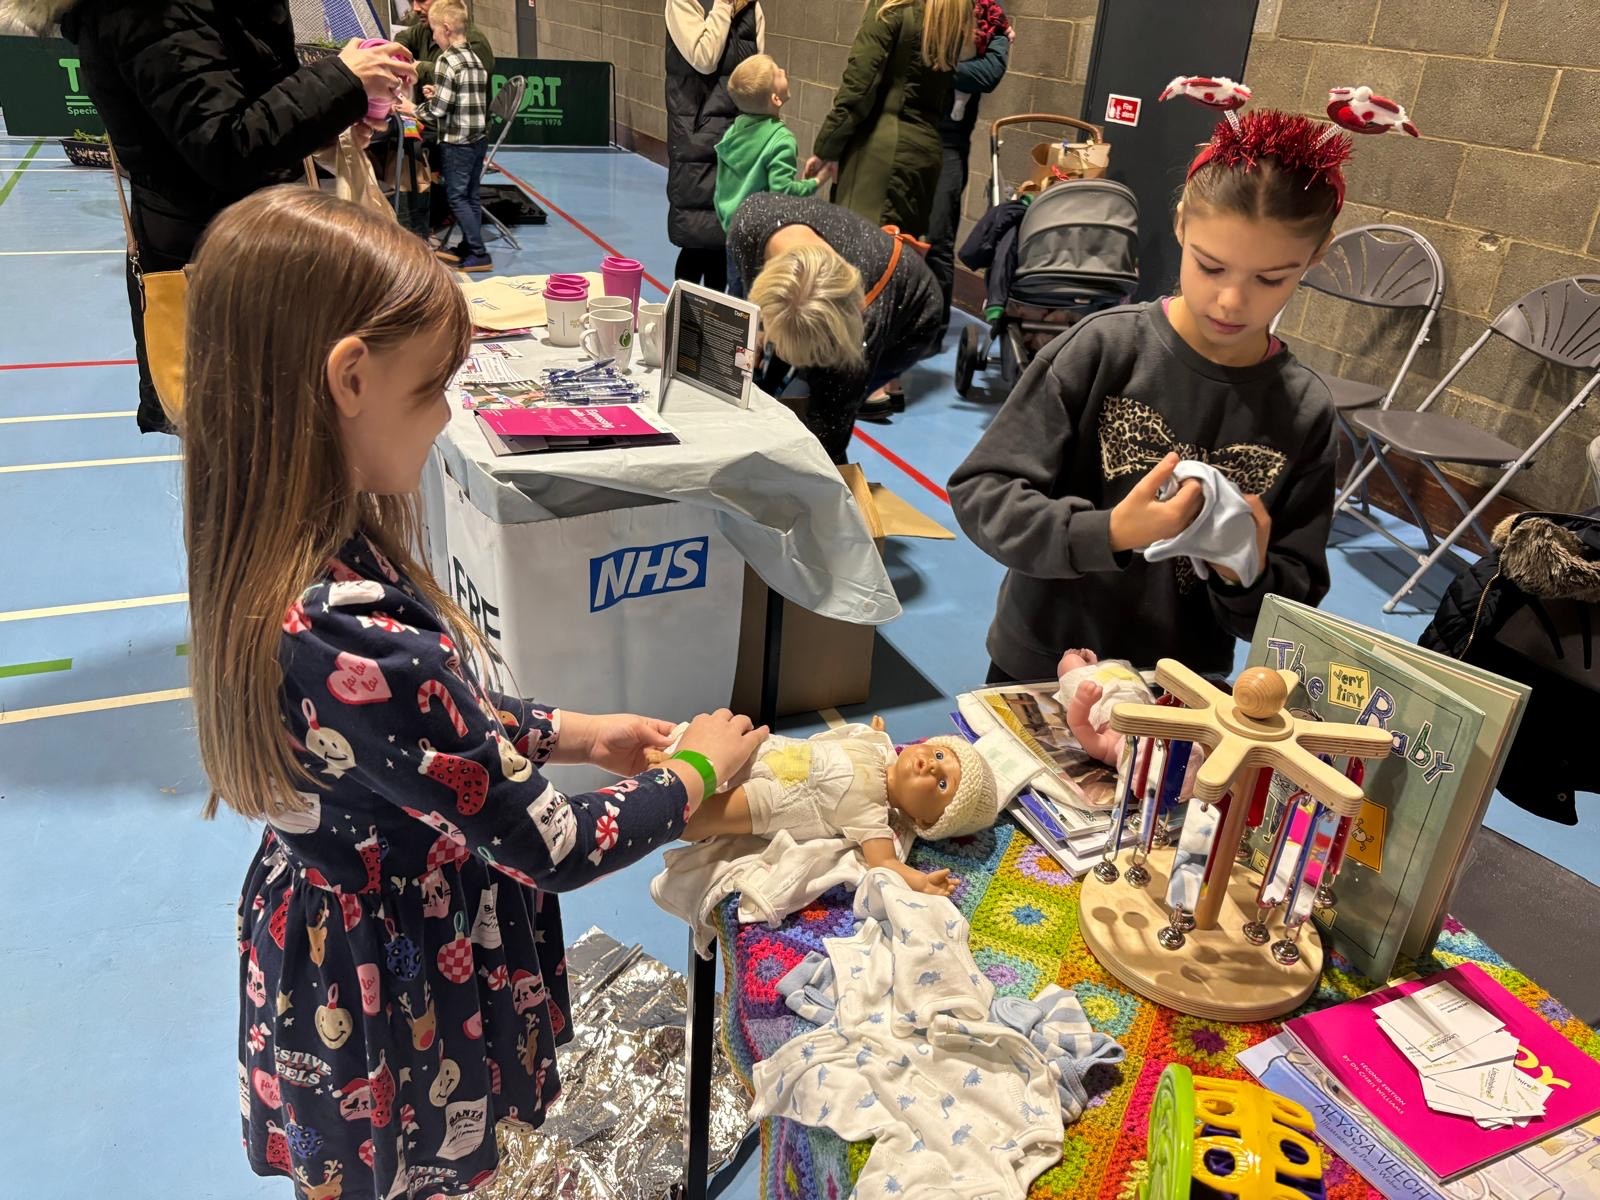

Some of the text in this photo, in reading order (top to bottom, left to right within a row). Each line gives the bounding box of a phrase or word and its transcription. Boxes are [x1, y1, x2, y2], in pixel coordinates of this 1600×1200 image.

[523, 118, 542, 126] Since
[593, 541, 704, 608] NHS
[342, 662, 366, 694] fa la
[361, 677, 378, 692] la
[1267, 638, 1325, 701] The
[1336, 684, 1365, 707] tiny
[1360, 1062, 1406, 1106] SECOND EDITION
[1376, 1087, 1405, 1115] WILLIAMS
[449, 1109, 484, 1127] SANTA
[1315, 1102, 1431, 1200] ALYSSA VEECH
[1319, 1118, 1353, 1150] Illustrated
[1360, 1153, 1378, 1172] Penny
